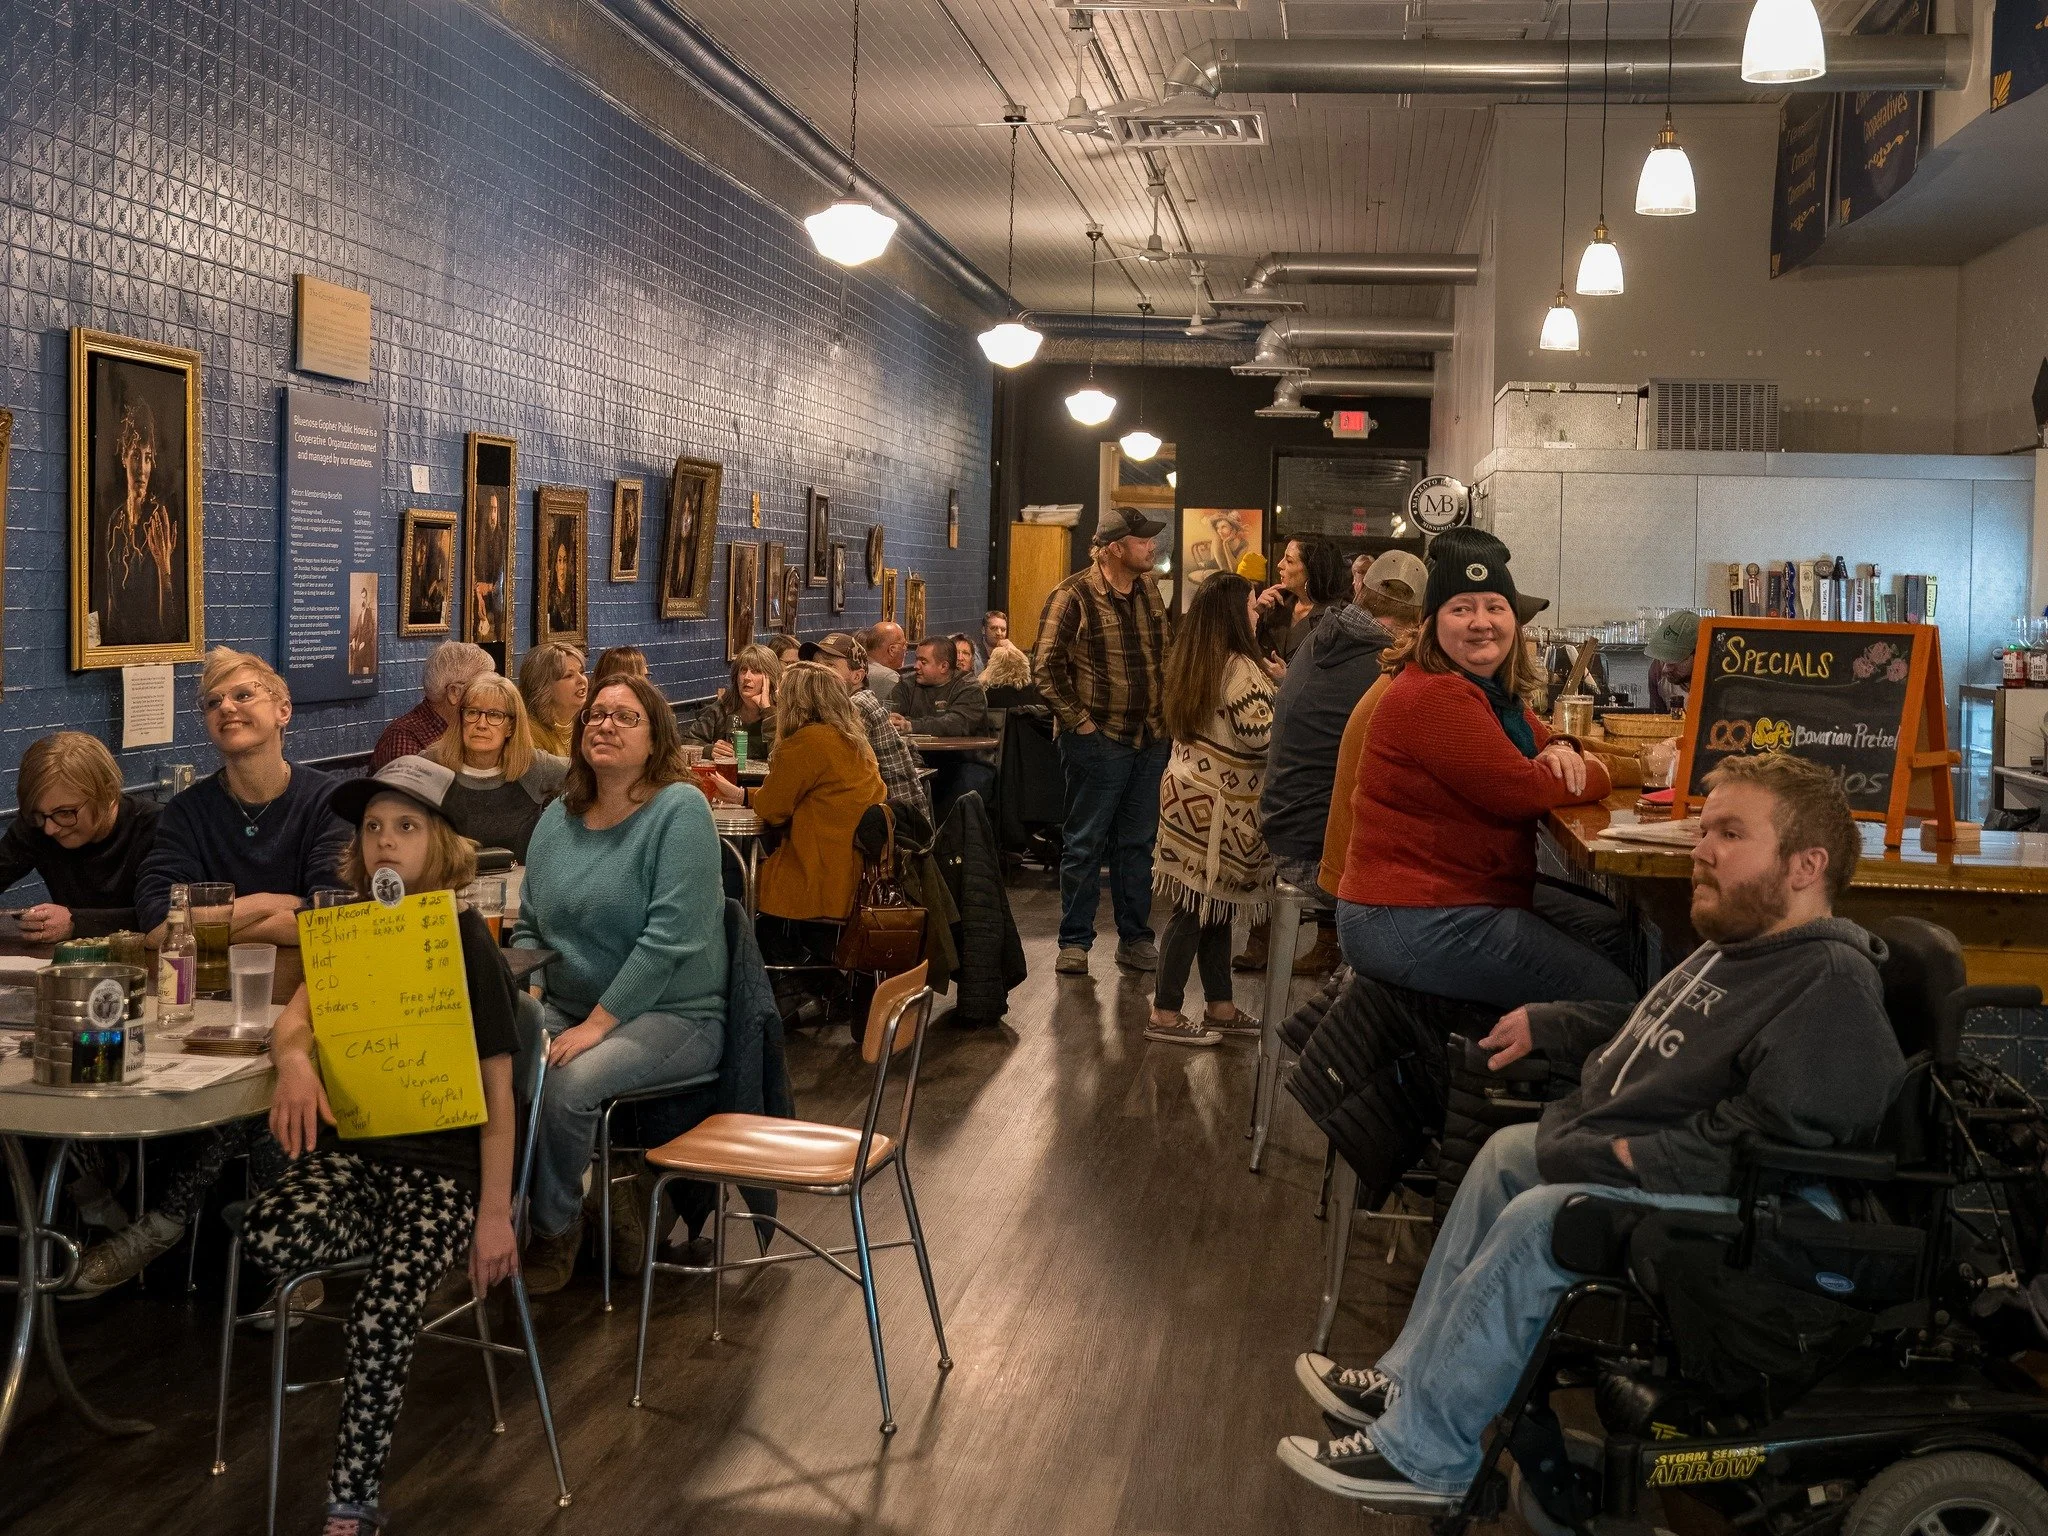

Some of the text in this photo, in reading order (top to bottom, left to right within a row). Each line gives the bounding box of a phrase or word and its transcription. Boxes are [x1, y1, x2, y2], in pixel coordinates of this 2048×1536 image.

[293, 414, 318, 428] Bluenose
[318, 419, 337, 432] Gopher
[338, 422, 353, 434] Public
[353, 425, 369, 436] House
[294, 432, 377, 453] Cooperative Organization owned
[297, 450, 308, 460] and
[308, 452, 333, 466] managed
[333, 453, 340, 467] by
[340, 457, 349, 465] our
[1412, 480, 1438, 508] MANKATO
[1424, 494, 1454, 513] MB
[1722, 635, 1833, 679] SPECIALS
[1753, 718, 1900, 749] Soft Bavarian Pretzel
[305, 910, 333, 927] Vinyl
[336, 906, 371, 922] Record
[306, 926, 358, 946] T-Shirt
[312, 953, 338, 970] Hat
[315, 975, 339, 992] CD
[316, 1000, 359, 1017] Stickers
[403, 1001, 462, 1018] or purchase
[345, 1033, 400, 1058] CASH
[382, 1050, 427, 1072] Card
[400, 1073, 450, 1089] Venmo
[421, 1087, 464, 1113] PayPal
[1659, 1446, 1758, 1465] STORM SERIES
[1650, 1456, 1759, 1486] ARROW
